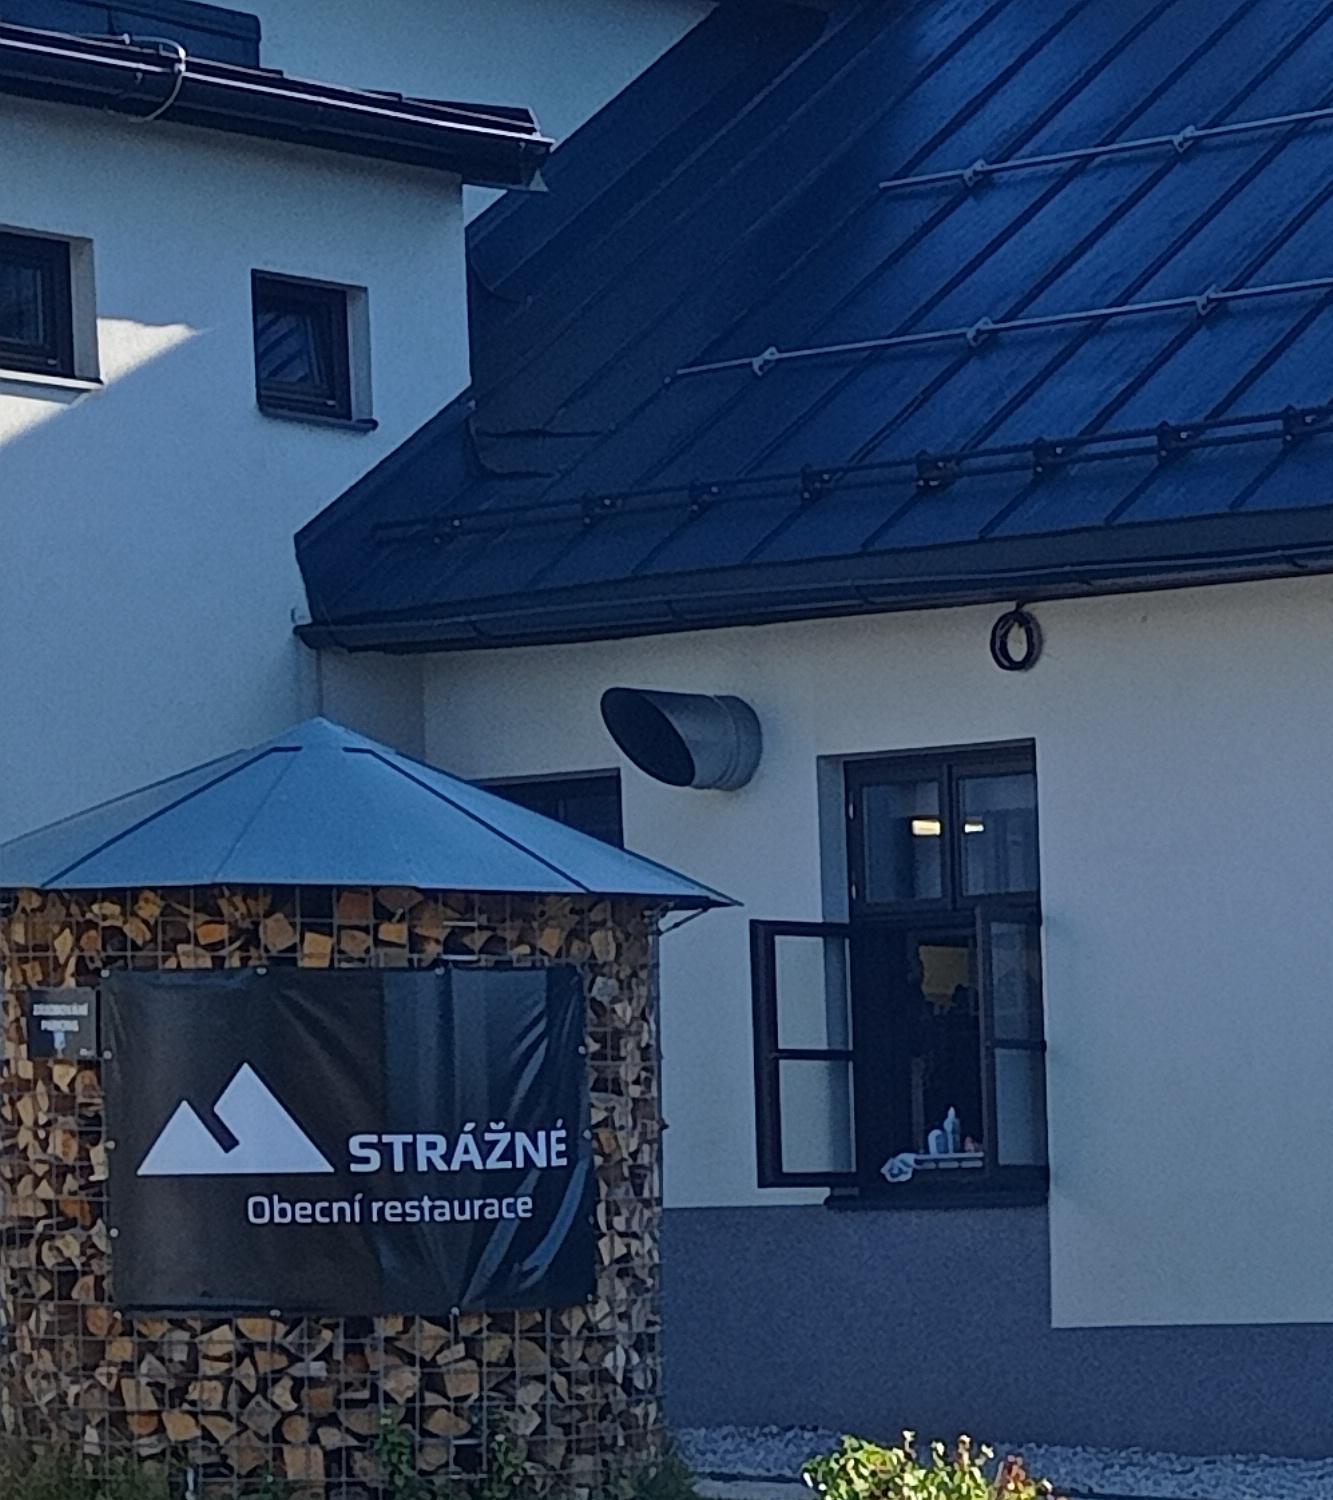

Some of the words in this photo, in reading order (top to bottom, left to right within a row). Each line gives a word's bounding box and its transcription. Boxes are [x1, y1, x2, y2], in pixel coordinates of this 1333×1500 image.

[349, 1118, 567, 1173] STRÁŽNÉ
[247, 1193, 363, 1224] Obecní
[371, 1195, 533, 1223] restaurace
